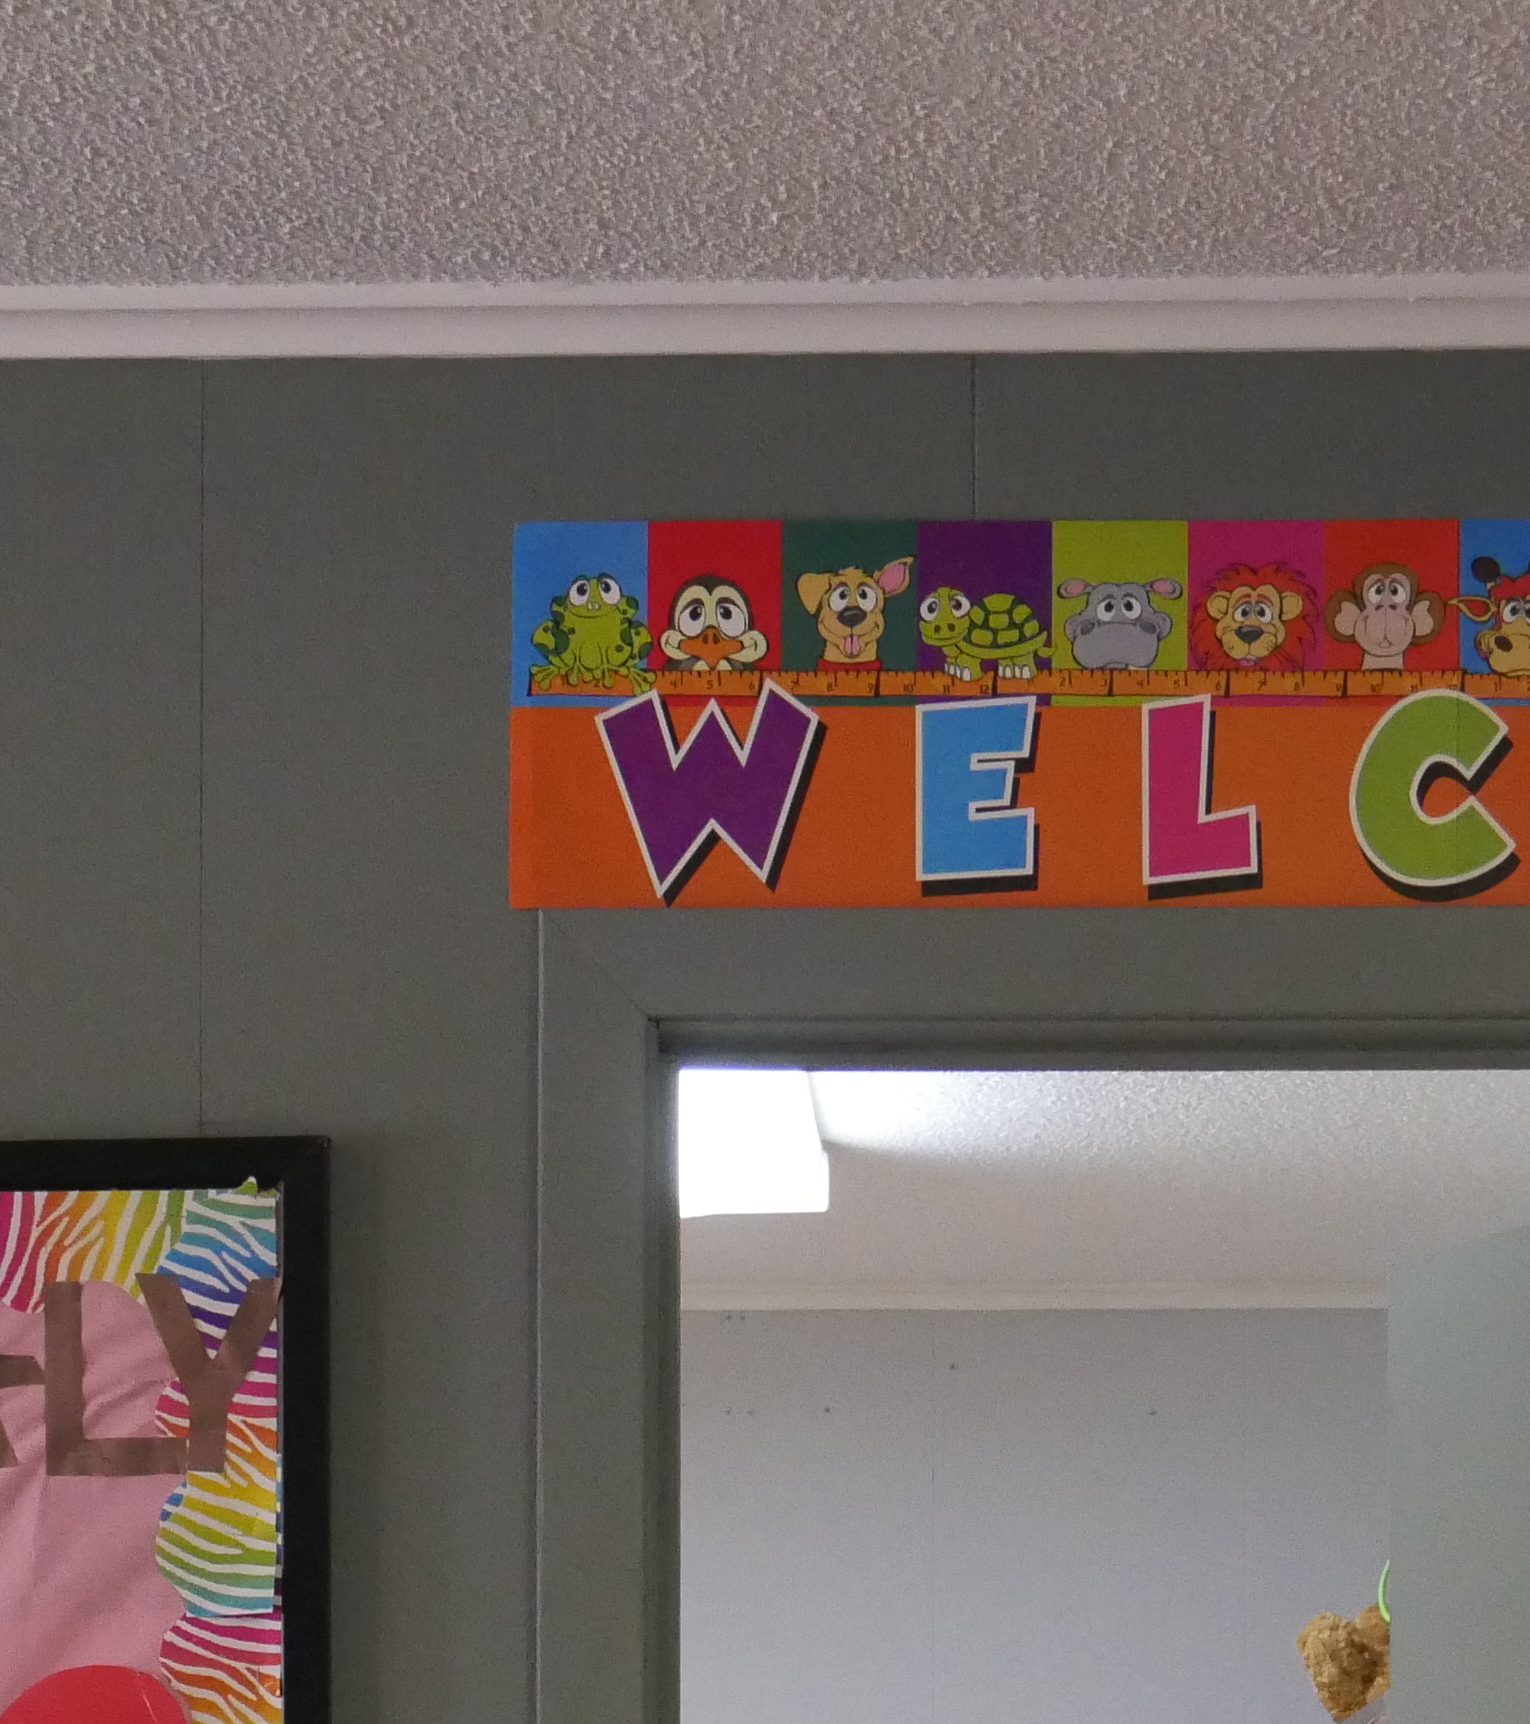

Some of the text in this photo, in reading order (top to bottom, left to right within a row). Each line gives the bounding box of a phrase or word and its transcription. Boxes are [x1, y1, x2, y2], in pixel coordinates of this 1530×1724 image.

[707, 679, 714, 690] 5
[749, 679, 756, 690] 6
[903, 682, 914, 693] 10
[943, 683, 951, 694] 11
[980, 683, 990, 694] 12
[1059, 677, 1066, 687] 2
[1215, 680, 1222, 690] 6
